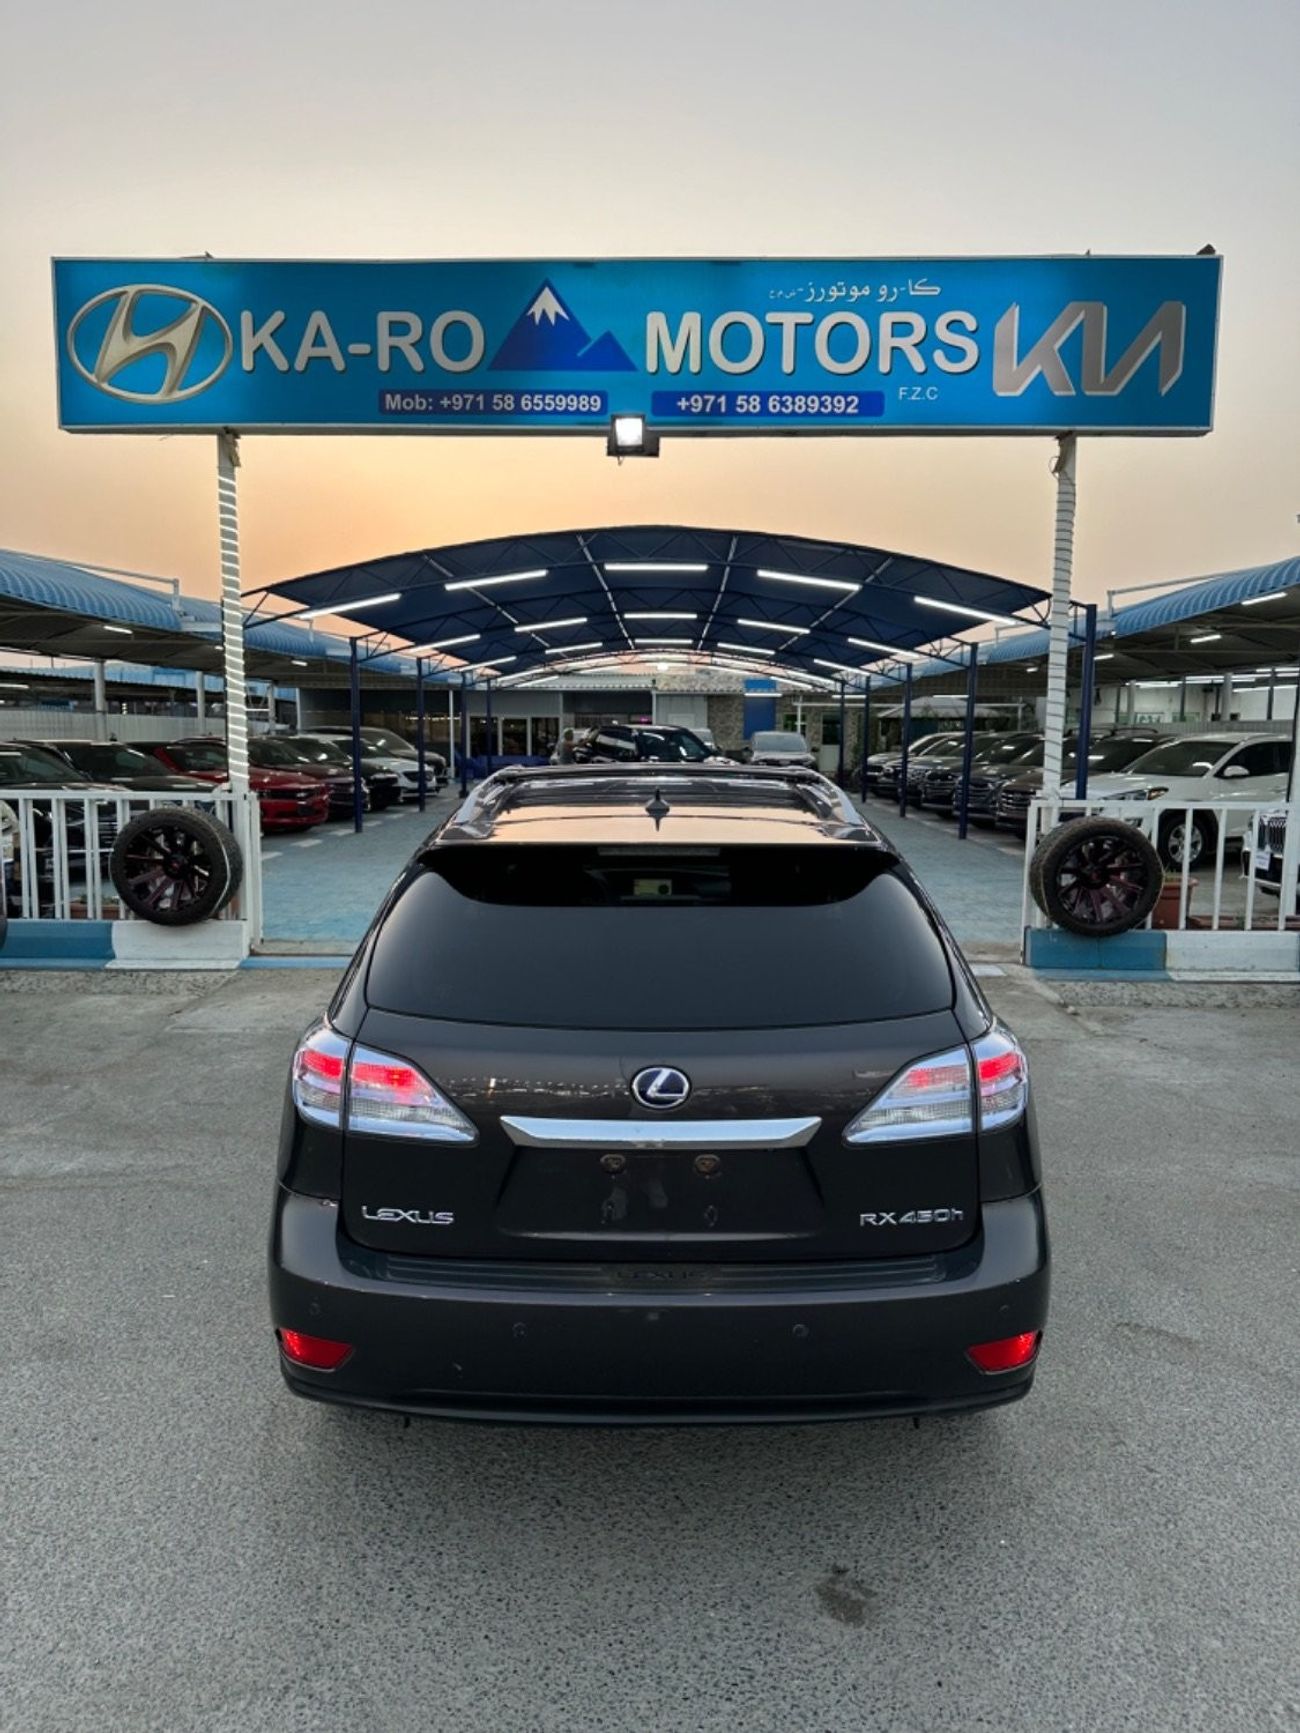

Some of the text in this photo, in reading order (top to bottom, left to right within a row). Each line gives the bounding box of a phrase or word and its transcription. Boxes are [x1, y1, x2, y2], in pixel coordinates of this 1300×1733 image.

[240, 310, 980, 375] KA-RO MOTORS
[385, 393, 602, 412] Mob: +971 58 6559989
[676, 395, 860, 414] +971 58 6389392
[361, 1205, 454, 1225] LEXUS
